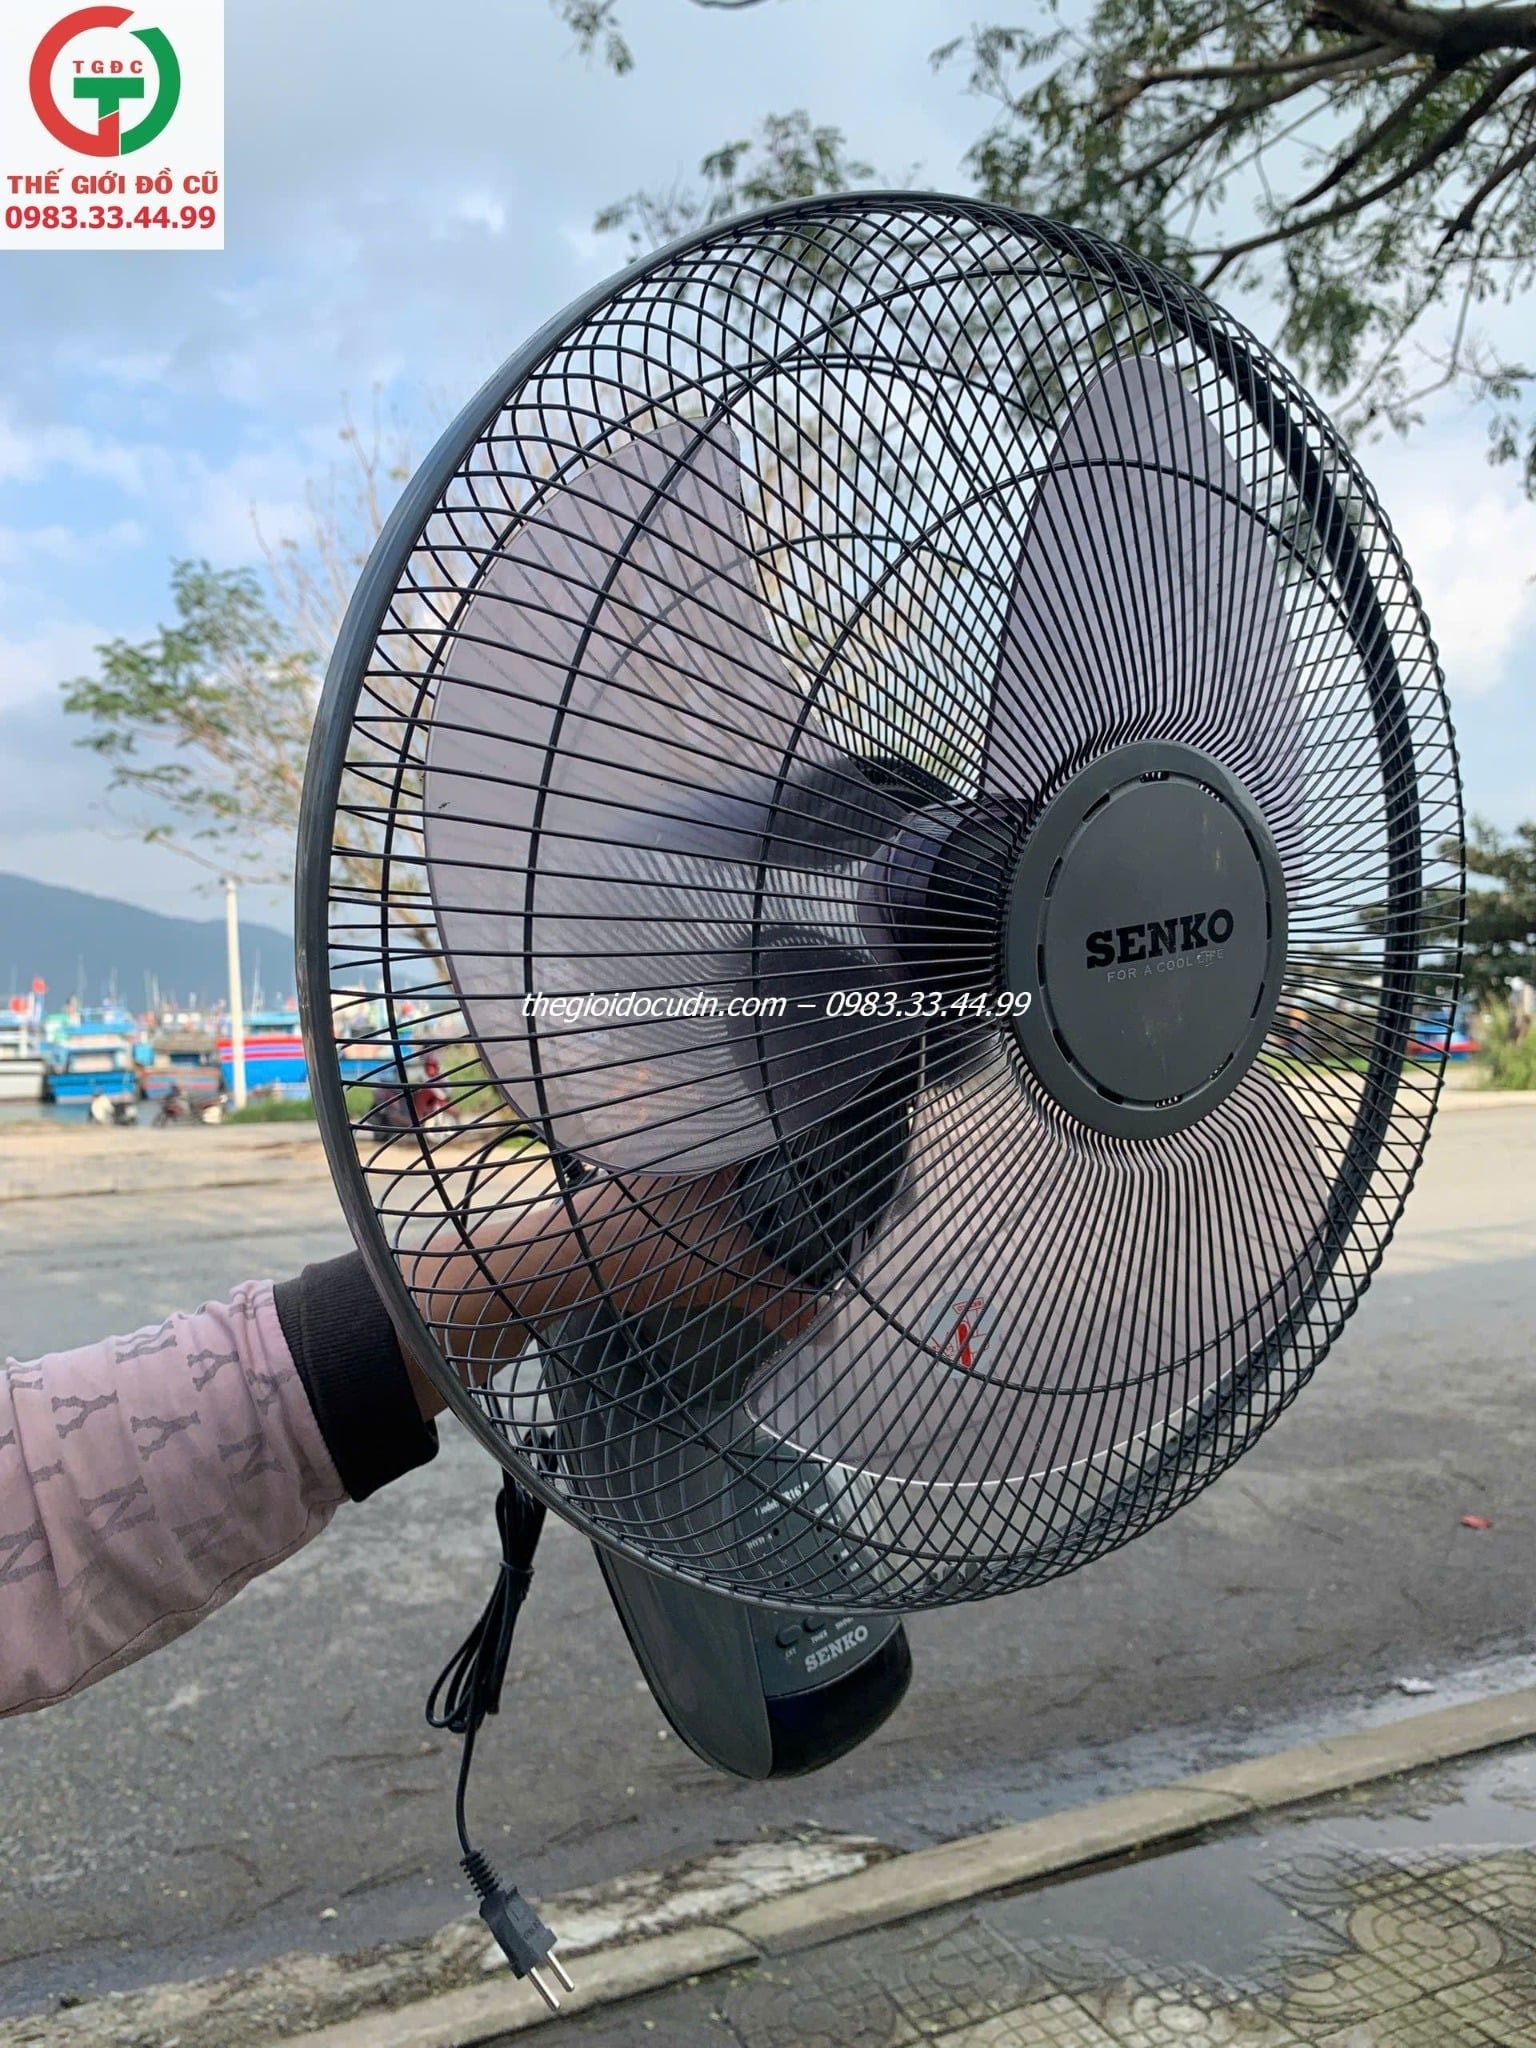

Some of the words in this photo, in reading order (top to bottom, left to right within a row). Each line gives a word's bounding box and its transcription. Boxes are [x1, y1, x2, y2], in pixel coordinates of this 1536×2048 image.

[1085, 908, 1234, 969] SENKO
[1107, 967, 1137, 983] FOR
[1144, 964, 1152, 976] A
[1157, 957, 1193, 973] COOL
[804, 1625, 868, 1673] SENKO
